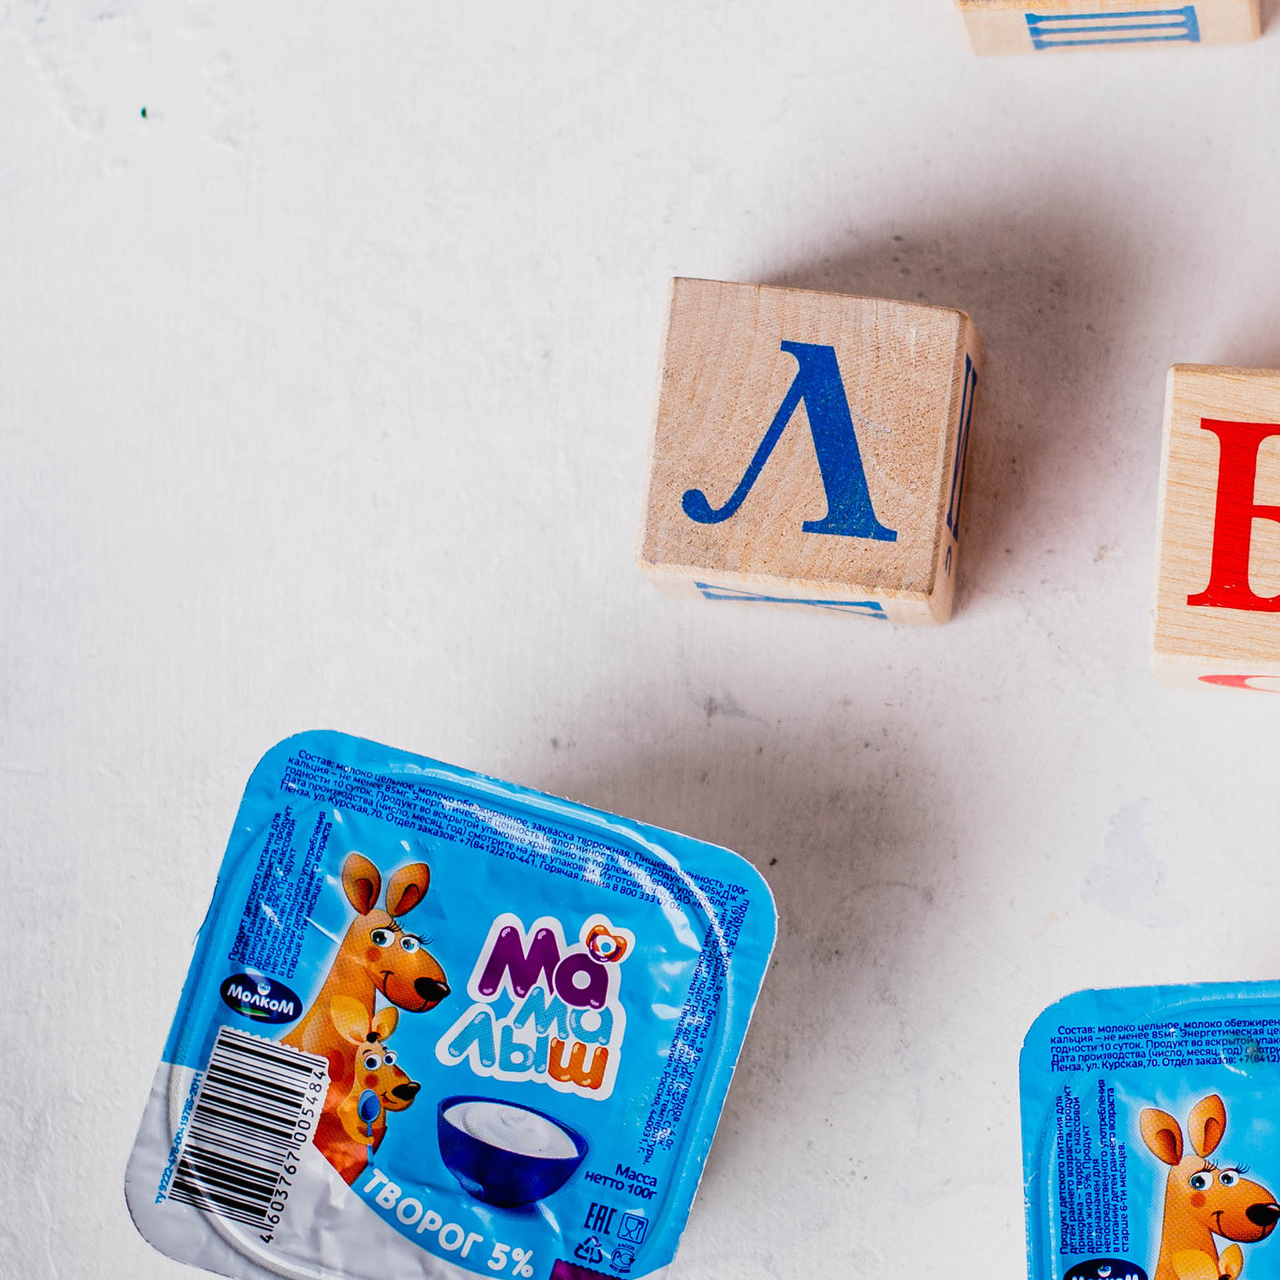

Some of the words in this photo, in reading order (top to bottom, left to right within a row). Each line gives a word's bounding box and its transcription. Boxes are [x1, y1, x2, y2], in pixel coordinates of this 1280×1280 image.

[682, 340, 897, 541] Л
[1050, 1034, 1093, 1045] кальция
[1117, 1032, 1149, 1041] менее
[1180, 1025, 1264, 1040] Энергетическая
[1051, 1044, 1097, 1054] годности
[1100, 1042, 1111, 1051] 10
[1113, 1042, 1143, 1051] суток.
[1145, 1037, 1190, 1050] Продукт
[1191, 1039, 1203, 1047] во
[1204, 1035, 1254, 1047] вскрытой
[1057, 1024, 1096, 1035] Состав:
[1097, 1024, 1136, 1033] молоко
[1137, 1021, 1182, 1033] цельное,
[1183, 1020, 1221, 1029] молоко
[1051, 1052, 1076, 1064] Дата
[1077, 1051, 1146, 1062] производства
[1147, 1046, 1185, 1059] (число,
[1222, 1043, 1243, 1056] год)
[1051, 1060, 1084, 1072] Пенза,
[1085, 1062, 1100, 1072] ул.
[1161, 1056, 1193, 1068] Отдел
[293, 1069, 328, 1143] 005484
[1056, 1096, 1066, 1114] для
[1063, 1084, 1074, 1127] продукт
[1097, 1079, 1110, 1148] употребления
[1108, 1088, 1118, 1130] возраста
[1056, 1117, 1066, 1159] питания
[1065, 1129, 1076, 1177] возраста,
[1081, 1124, 1094, 1168] Продукт
[1109, 1131, 1119, 1171] раннего
[584, 1170, 626, 1191] нетто
[628, 1183, 658, 1200] 100г
[615, 1163, 659, 1188] Масса
[1058, 1161, 1070, 1208] детского
[1083, 1171, 1093, 1189] 5%.
[1093, 1159, 1102, 1178] для
[1118, 1142, 1130, 1187] месяцев.
[265, 1151, 302, 1224] 603767
[1067, 1179, 1078, 1221] раннего
[1085, 1191, 1095, 1218] жира
[1101, 1151, 1114, 1252] непосредственного
[1119, 1189, 1129, 1211] 6-ти
[260, 1232, 274, 1242] 4
[363, 1166, 483, 1259] ТВОРОГ
[487, 1242, 534, 1278] 5%
[1059, 1210, 1071, 1254] Продукт
[1077, 1202, 1087, 1254] прикорма
[1093, 1180, 1105, 1253] предназначен
[1112, 1204, 1121, 1245] питании
[1121, 1213, 1131, 1253] старше
